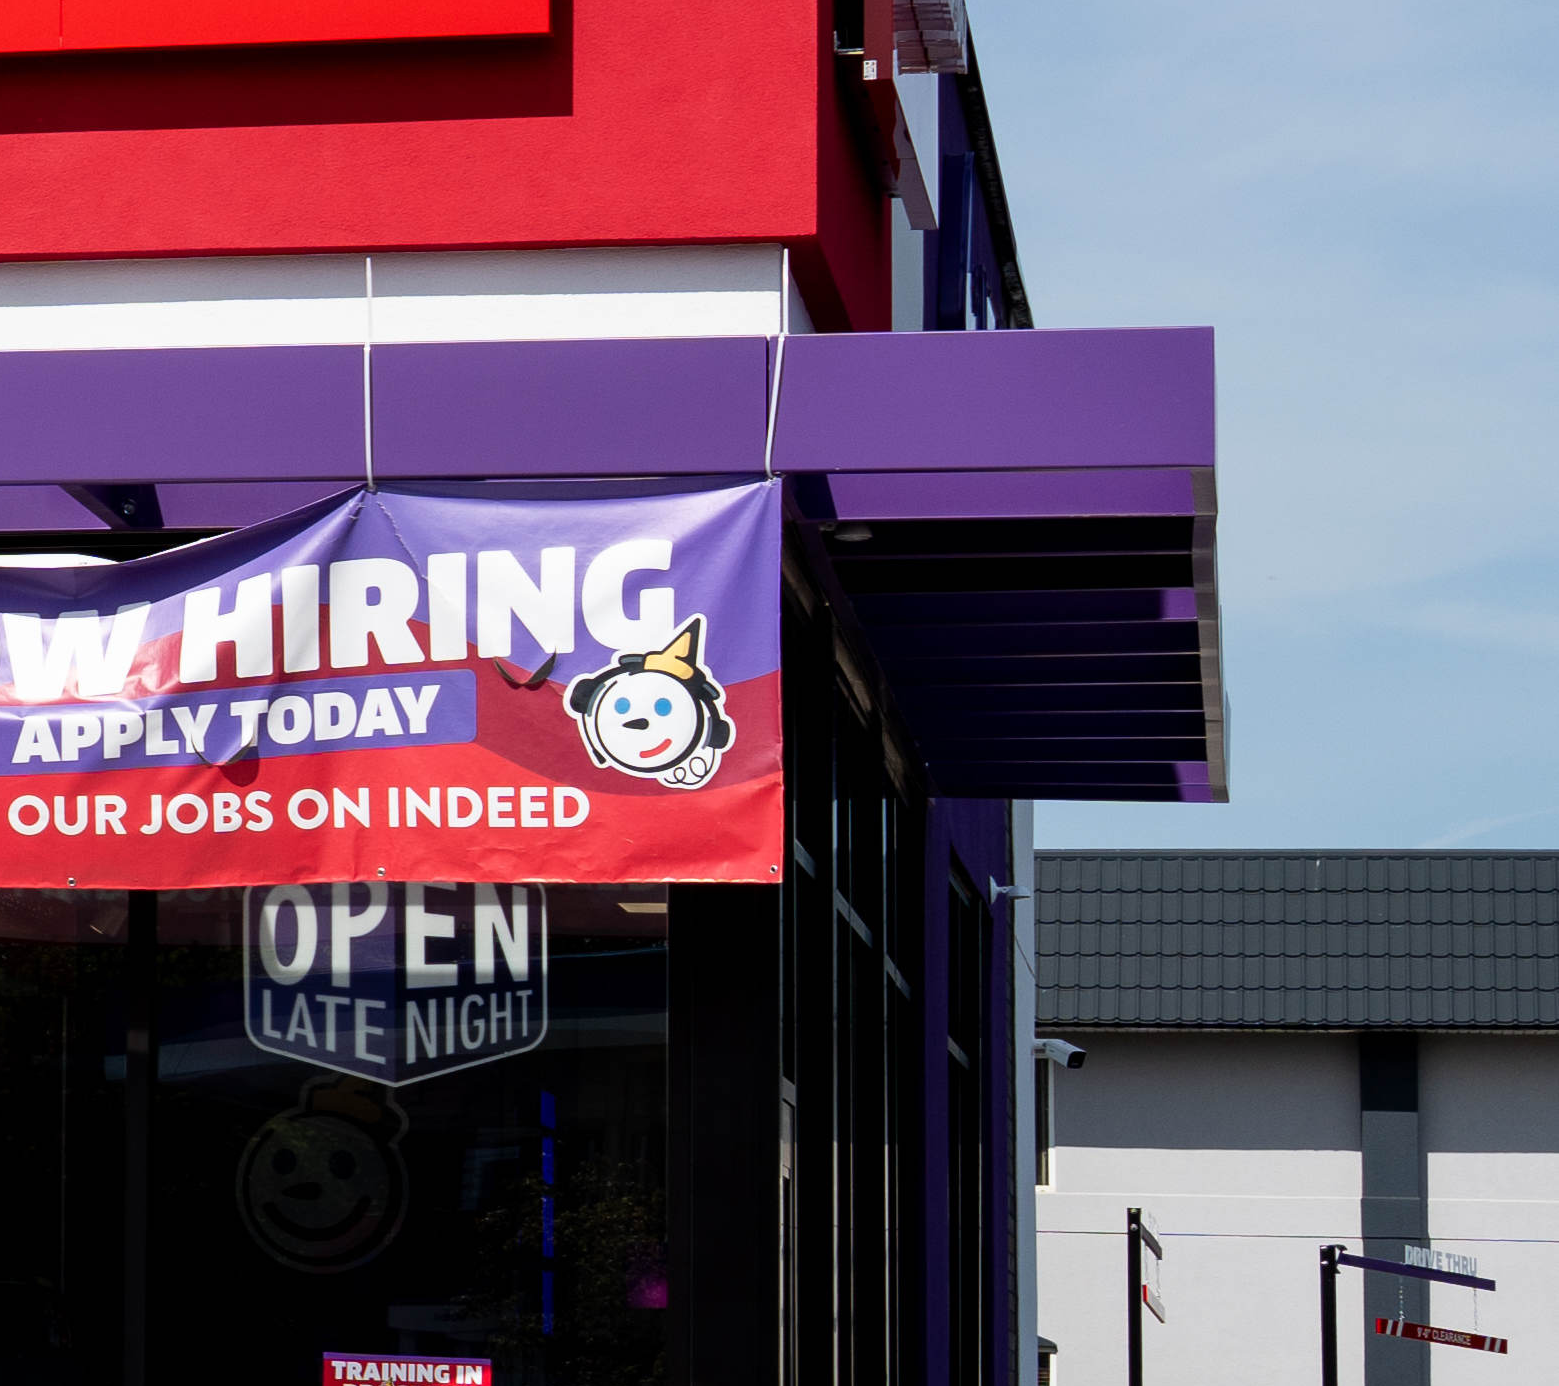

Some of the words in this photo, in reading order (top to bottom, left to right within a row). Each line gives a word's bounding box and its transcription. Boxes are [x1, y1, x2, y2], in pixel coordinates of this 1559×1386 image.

[179, 539, 675, 684] HIRING
[12, 704, 217, 764] APPLY
[229, 683, 440, 750] TODAY
[7, 793, 128, 836] OUR
[140, 790, 274, 835] JOBS
[286, 787, 369, 831] ON
[389, 785, 590, 829] INDEED
[259, 881, 528, 989] OPEN
[262, 989, 386, 1064] LATE
[406, 990, 533, 1064] NIGHT
[1404, 1245, 1443, 1271] DRIVE
[1445, 1253, 1477, 1277] THRU
[331, 1360, 450, 1384] TRAINING
[455, 1365, 483, 1385] IN
